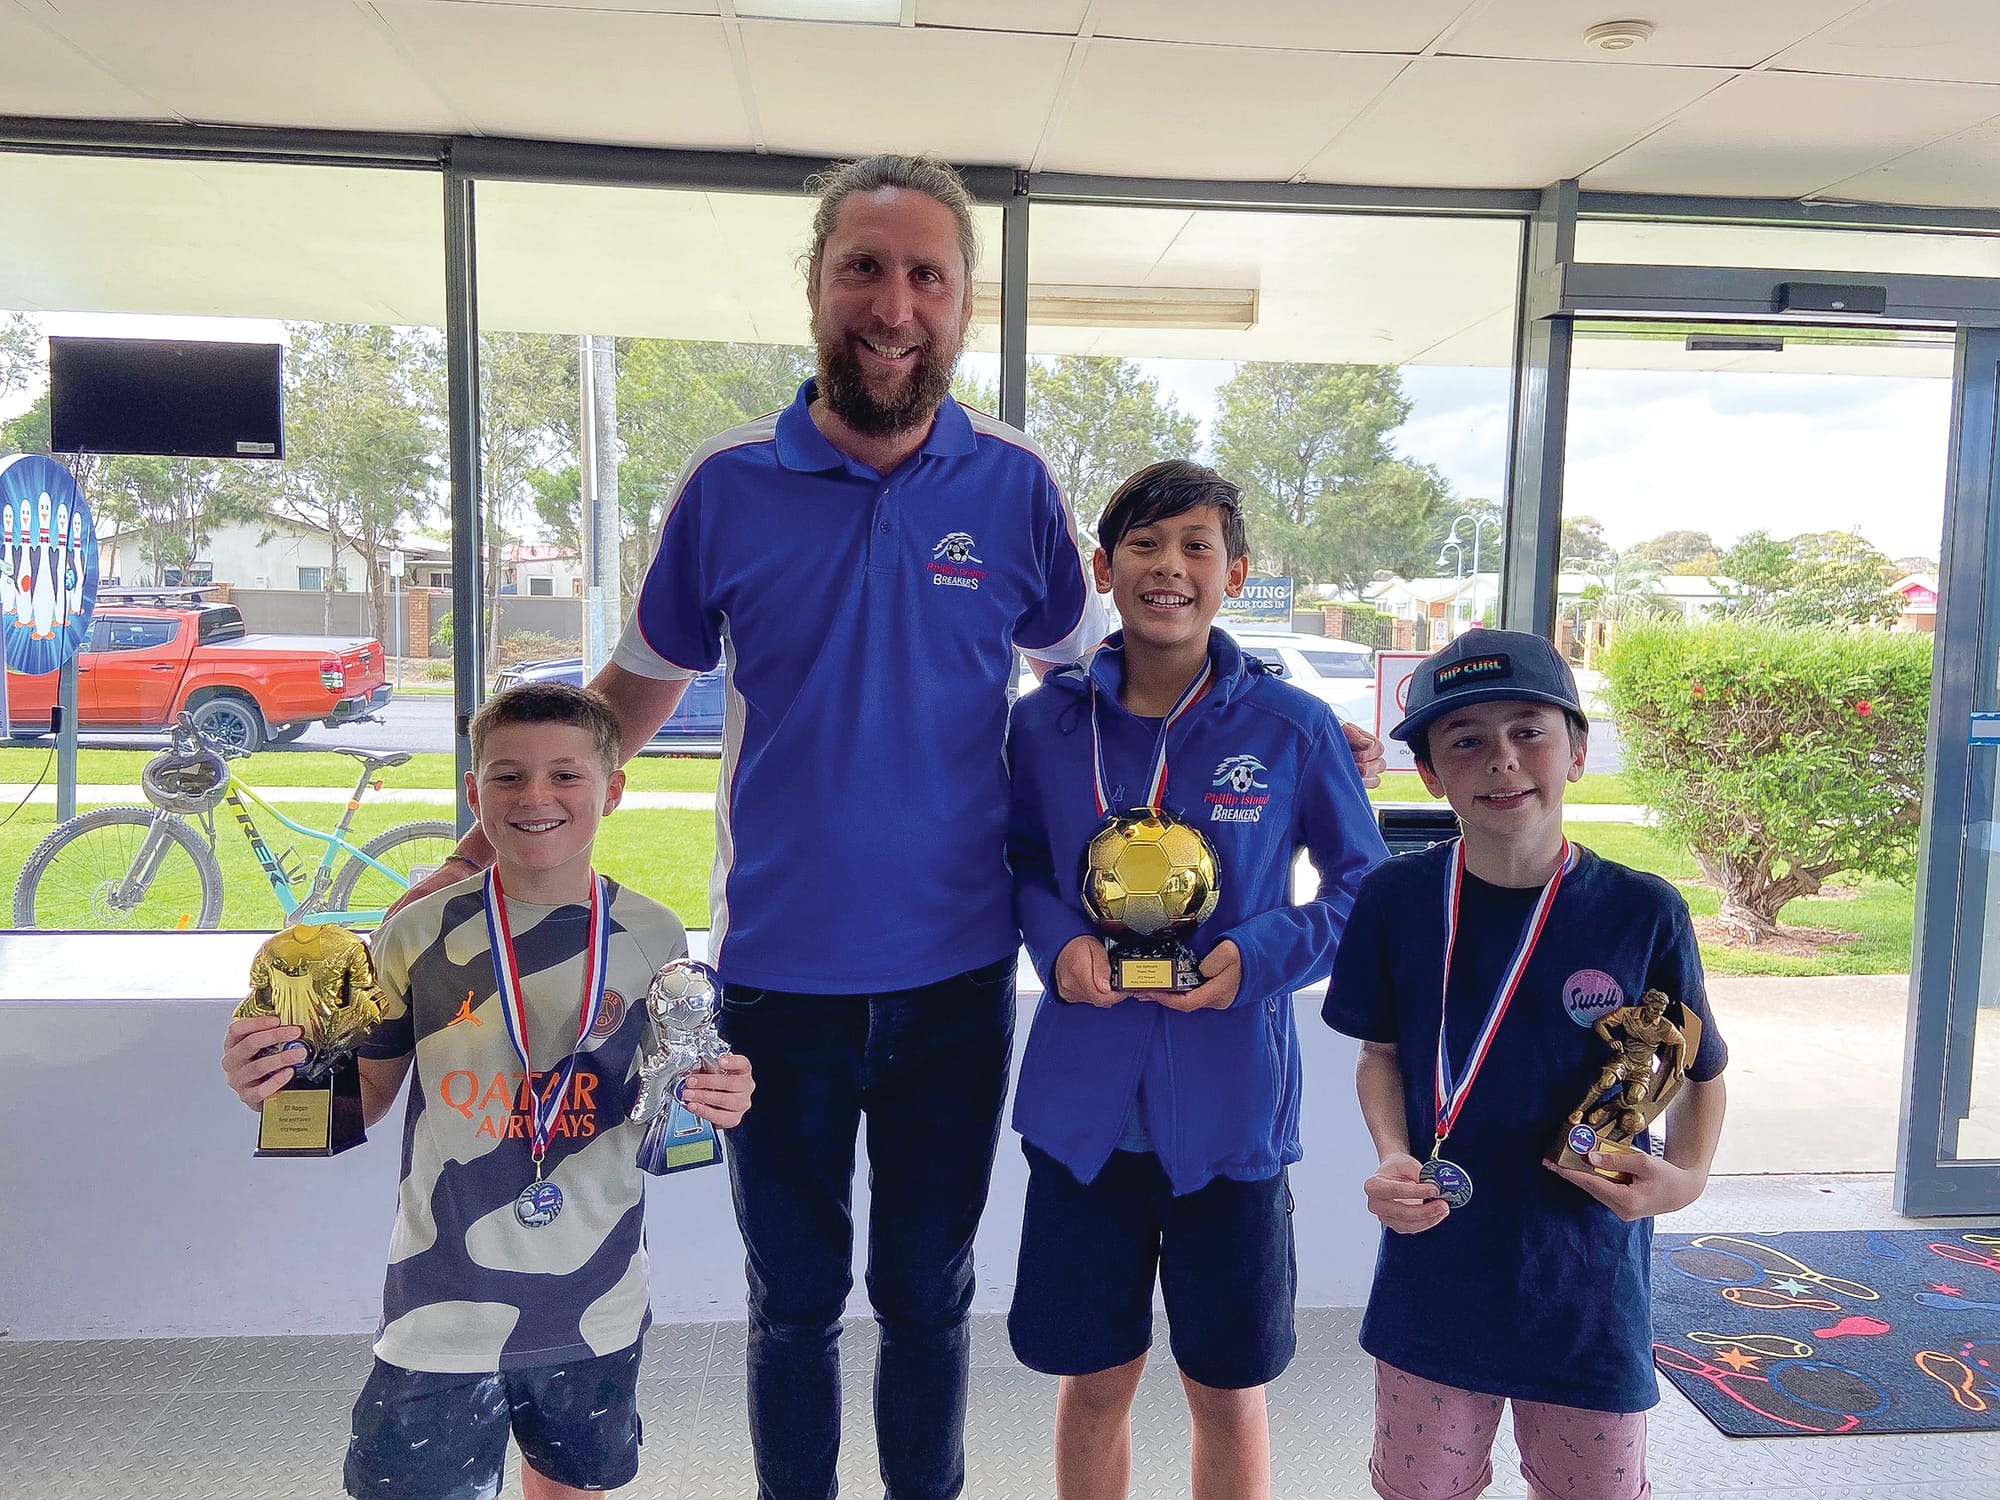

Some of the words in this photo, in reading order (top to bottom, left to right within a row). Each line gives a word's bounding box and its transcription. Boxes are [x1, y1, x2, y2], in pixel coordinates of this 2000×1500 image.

[933, 573, 979, 590] BREAKERS
[1226, 600, 1250, 609] YOUR
[1250, 600, 1273, 609] TOES
[1275, 600, 1285, 609] IN
[1439, 665, 1461, 683] RIP
[1463, 658, 1502, 674] CURL
[1203, 792, 1238, 807] Phillip
[1210, 804, 1262, 823] BREAKERS
[226, 787, 286, 889] TREK
[1569, 987, 1618, 1011] Swell
[440, 1070, 599, 1120] QATAR
